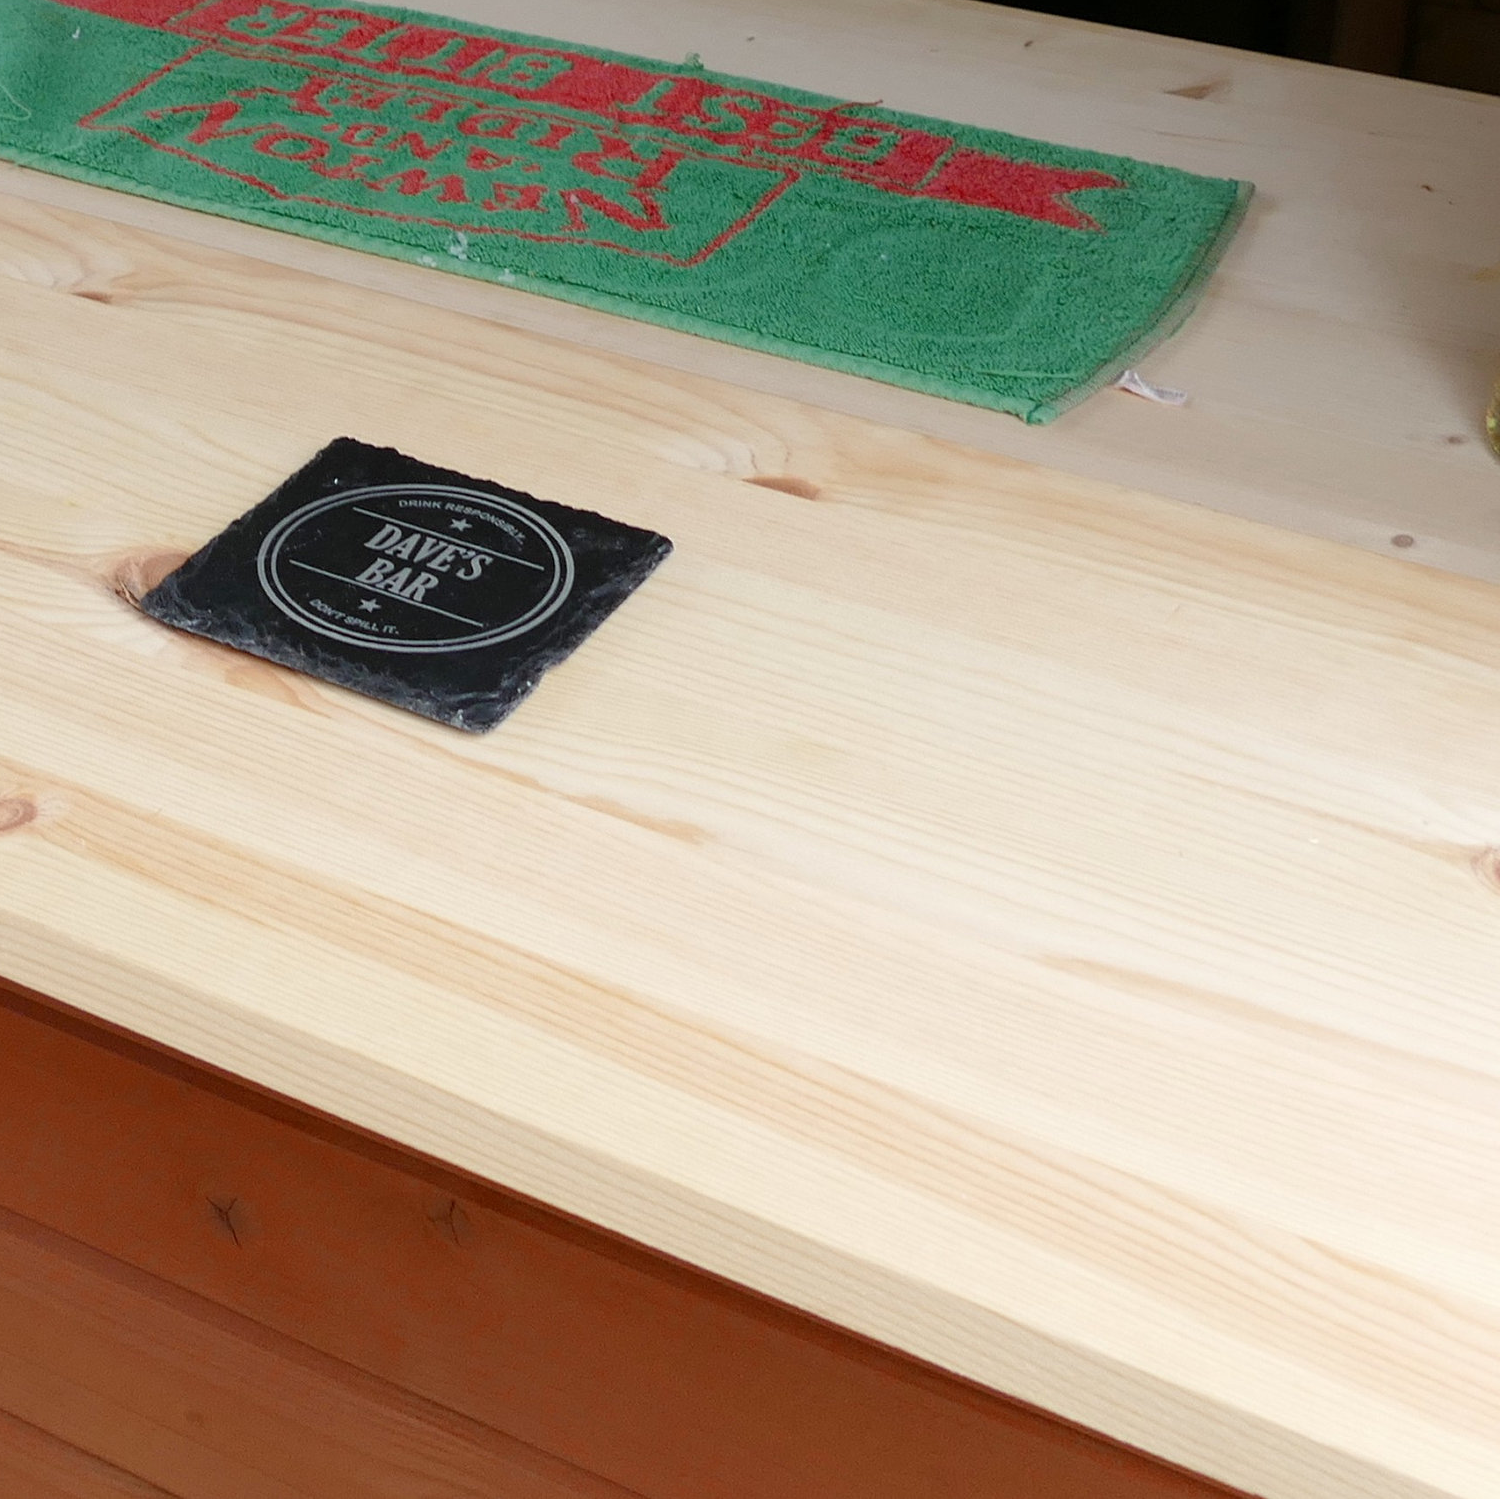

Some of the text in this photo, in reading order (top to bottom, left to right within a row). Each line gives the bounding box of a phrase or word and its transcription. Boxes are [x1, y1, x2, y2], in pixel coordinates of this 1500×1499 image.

[224, 4, 901, 162] BEST BITTER
[228, 74, 691, 192] RIDLEY
[143, 100, 673, 232] NEWTON
[398, 499, 442, 510] DRINK
[355, 557, 439, 602] BAR
[364, 523, 494, 582] DAVE'S
[310, 598, 342, 621] DON'T
[343, 614, 379, 633] SPILL
